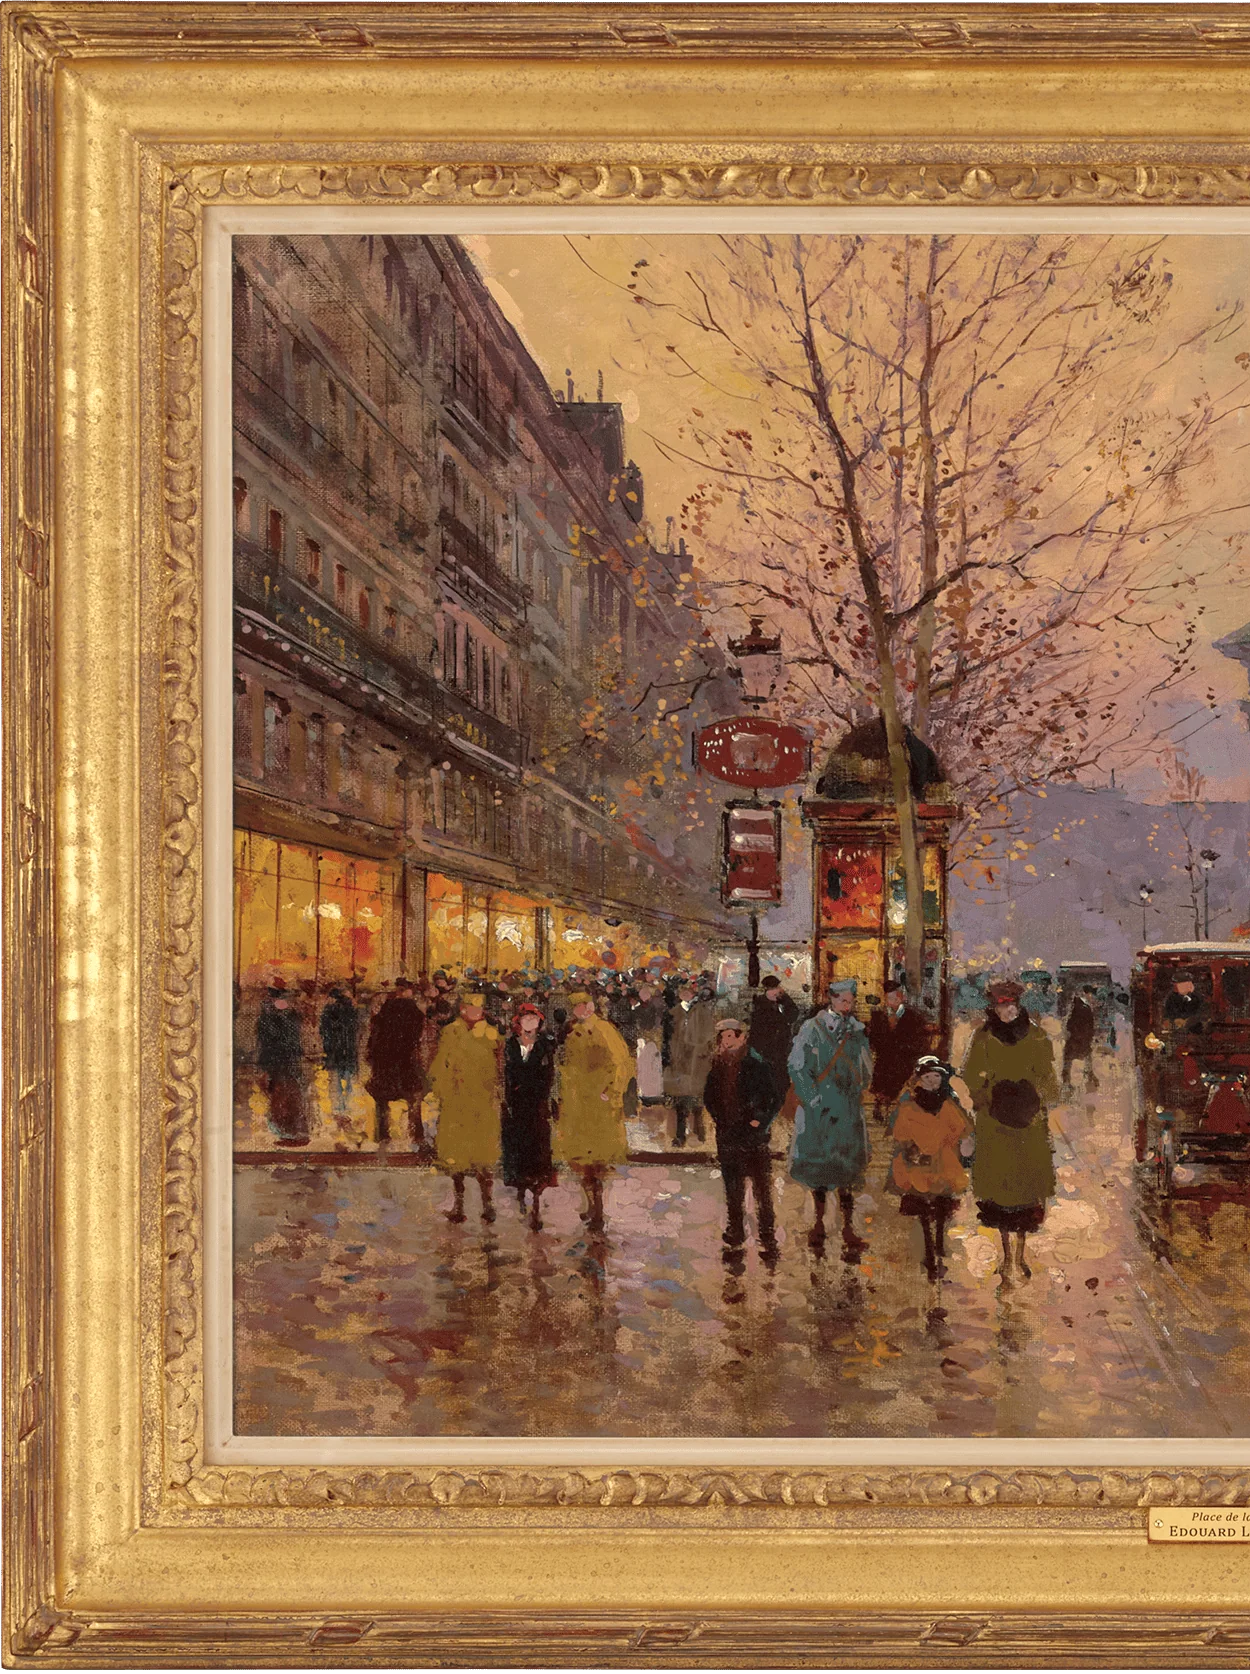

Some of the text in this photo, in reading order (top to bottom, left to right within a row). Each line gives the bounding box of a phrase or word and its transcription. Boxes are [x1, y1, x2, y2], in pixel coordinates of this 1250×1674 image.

[1191, 1512, 1222, 1521] Place
[1225, 1512, 1239, 1521] de
[1169, 1525, 1236, 1537] EDOUARD
